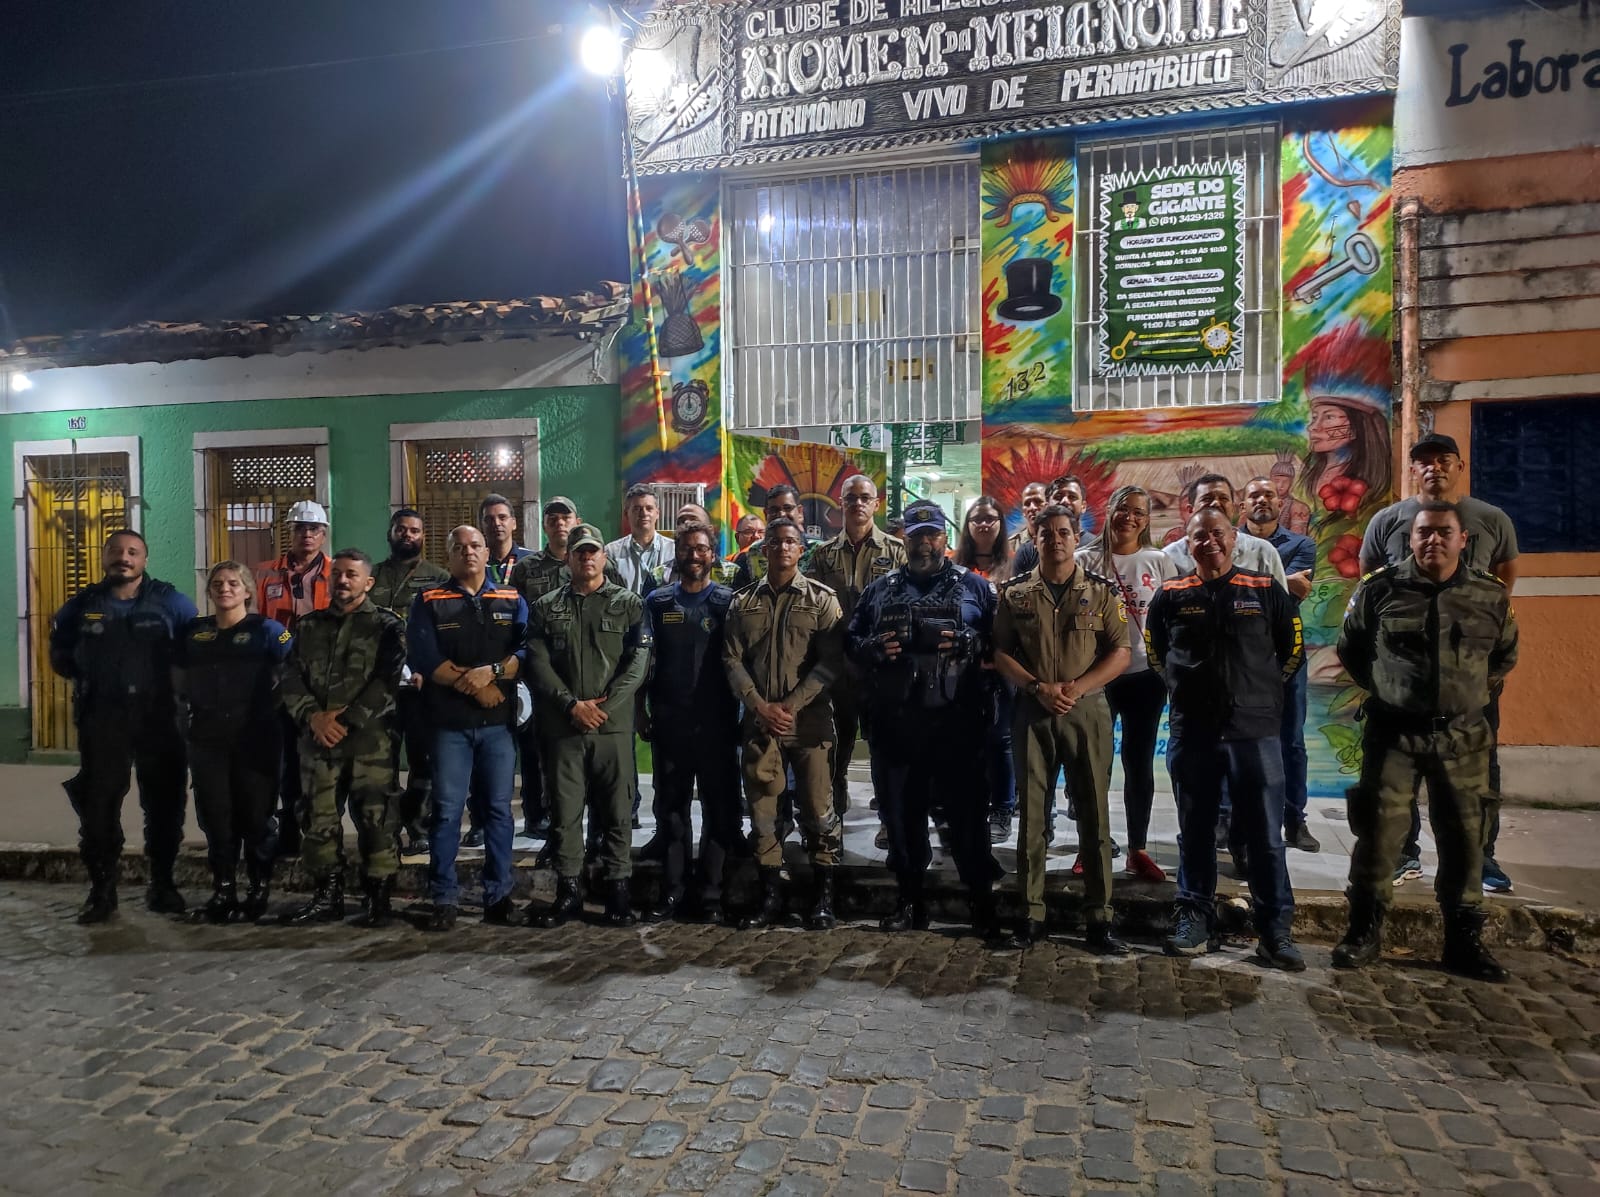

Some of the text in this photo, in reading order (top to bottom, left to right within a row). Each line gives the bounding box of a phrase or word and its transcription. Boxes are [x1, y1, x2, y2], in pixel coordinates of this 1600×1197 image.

[745, 0, 841, 40] CLUBE
[850, 0, 889, 25] DE
[741, 49, 1234, 140] PATRIMÔNIO VIVO DE PERNAMBUCO
[1148, 195, 1227, 216] GIGANTE
[1151, 179, 1225, 199] SEDE DO
[1007, 361, 1046, 401] 132
